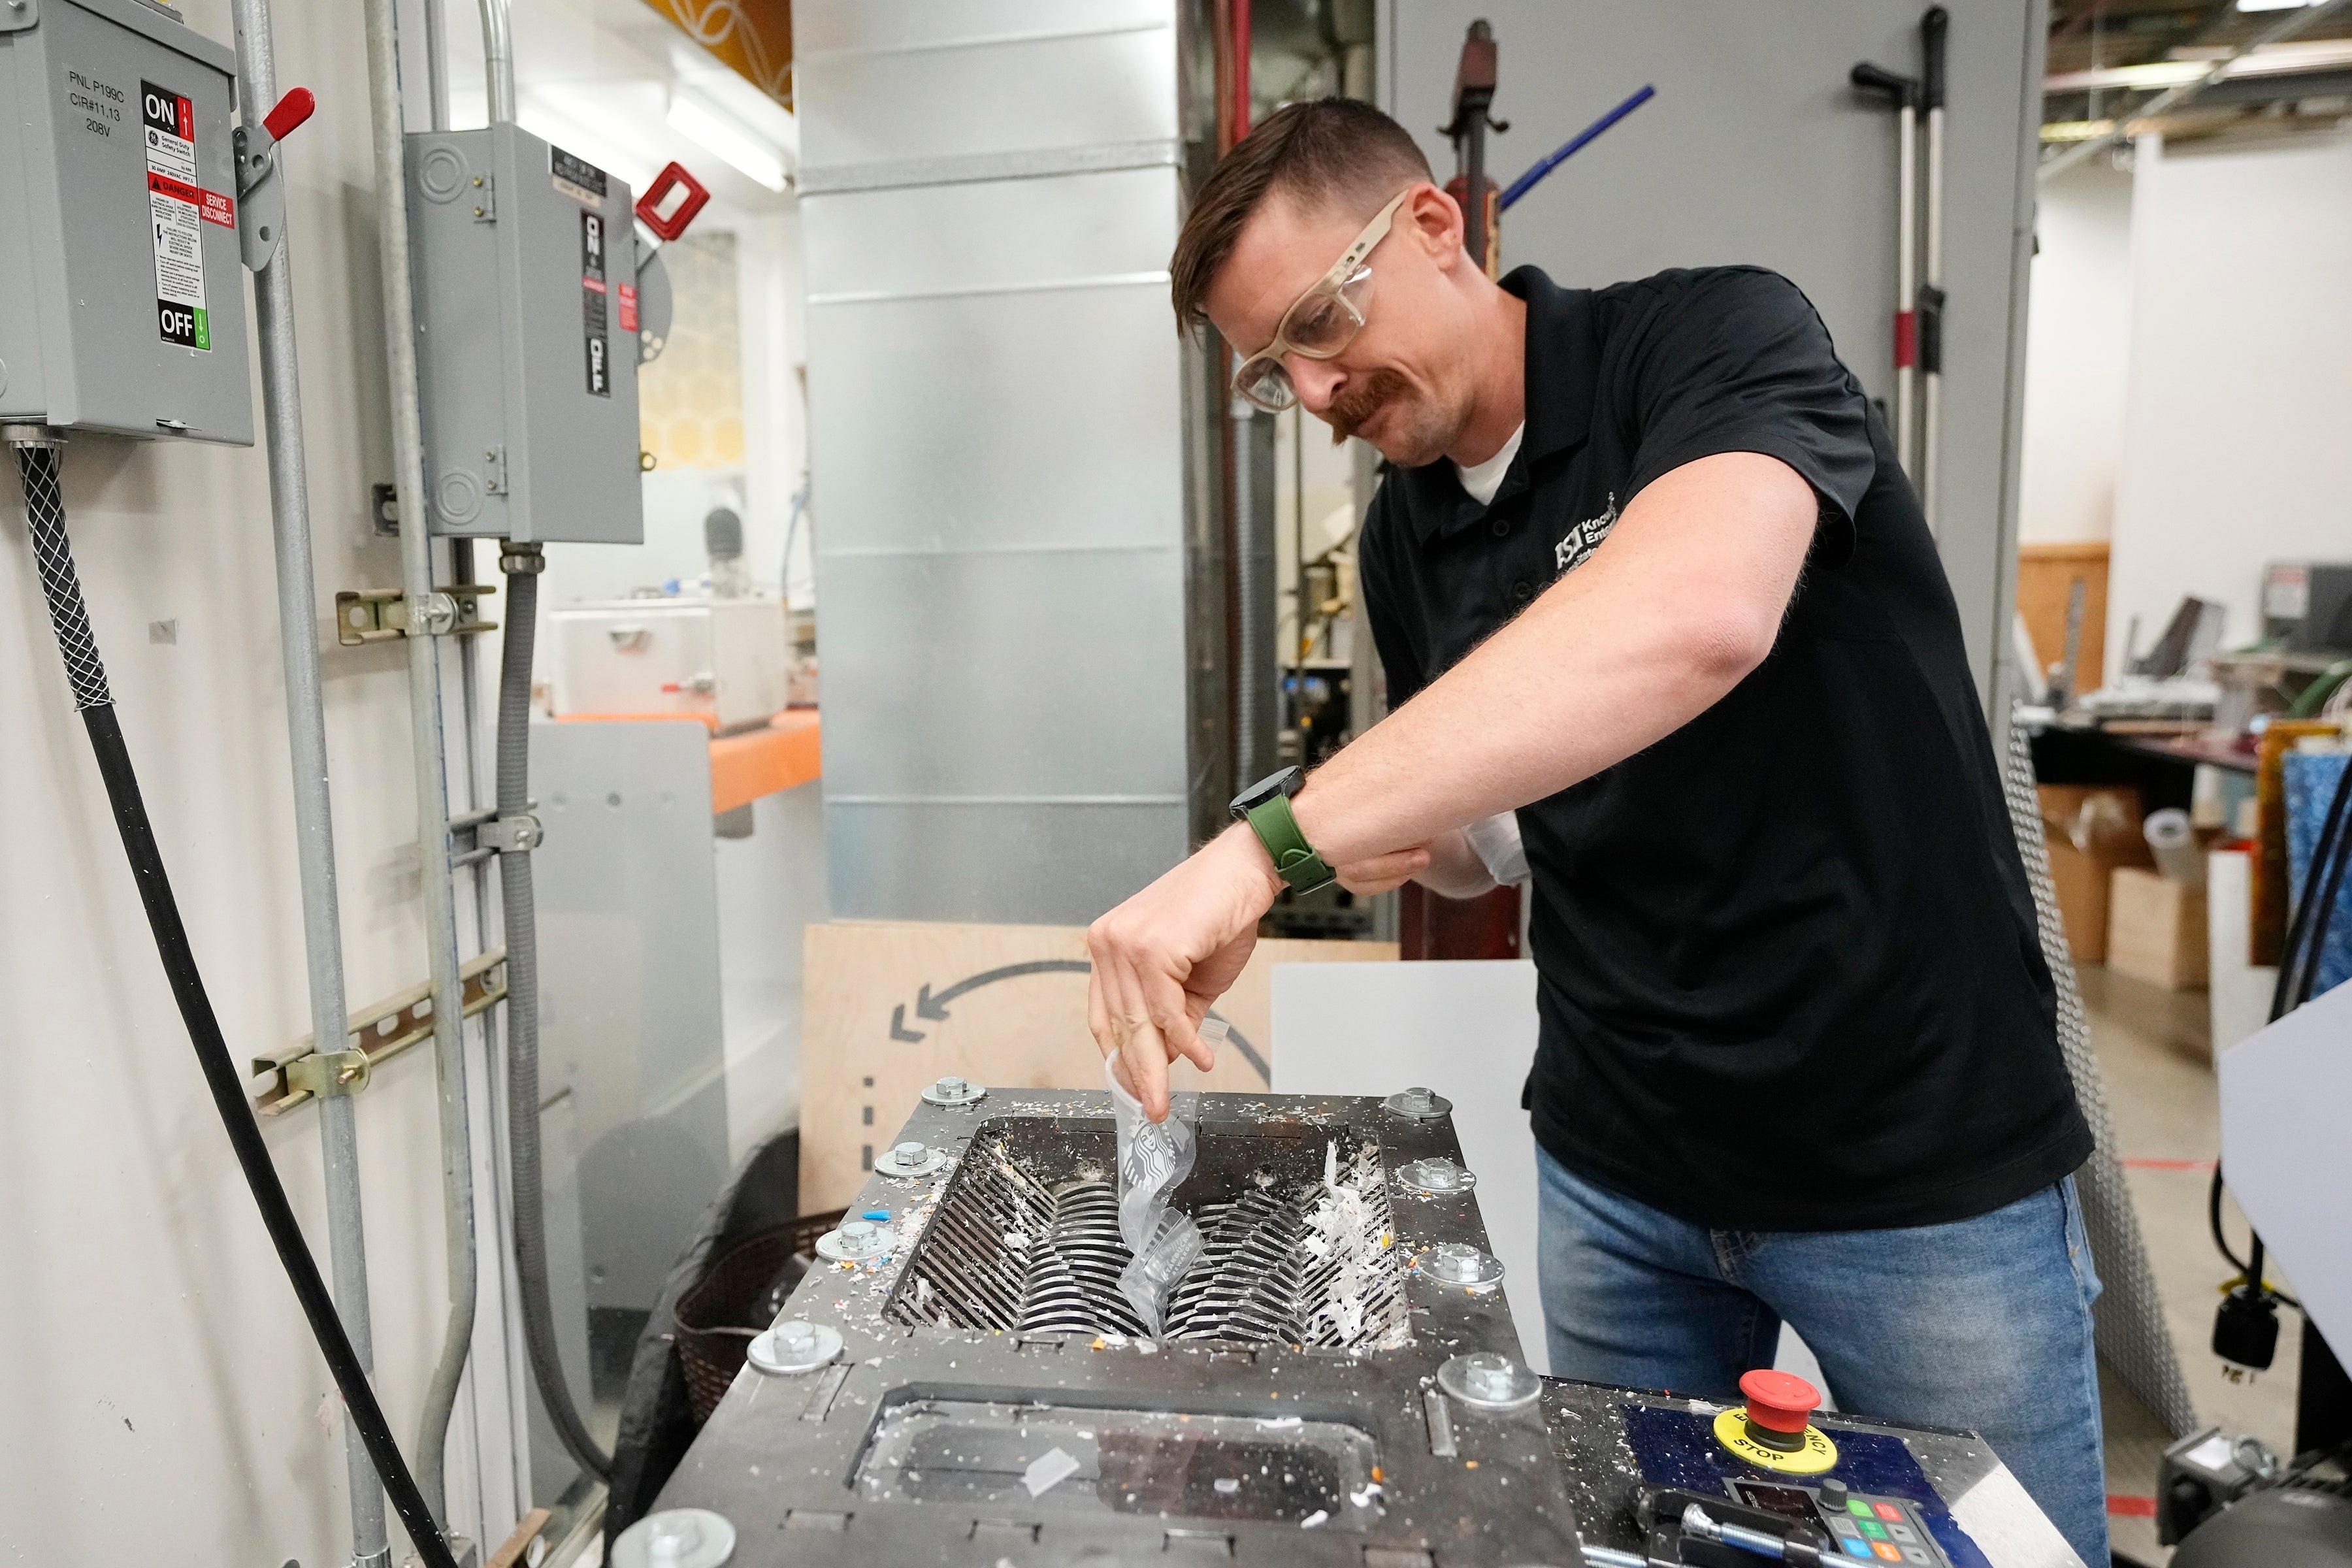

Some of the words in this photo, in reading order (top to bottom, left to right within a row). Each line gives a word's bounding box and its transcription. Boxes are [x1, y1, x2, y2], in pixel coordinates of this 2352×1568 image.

[69, 71, 91, 90] PNL
[93, 80, 124, 103] P199C
[146, 93, 174, 126] ON
[86, 118, 110, 137] 208V
[161, 135, 178, 146] General
[179, 142, 189, 151] Duty
[161, 142, 176, 153] Safety
[176, 147, 191, 157] Switch
[163, 182, 194, 198] DANGER
[206, 193, 227, 211] SERVICE
[202, 204, 232, 225] DISCONNECT
[587, 216, 600, 255] ON
[161, 309, 193, 337] OFF
[591, 338, 604, 392] OFF
[1171, 1243, 1192, 1277] REWARDS
[1733, 1438, 1784, 1461] STOP
